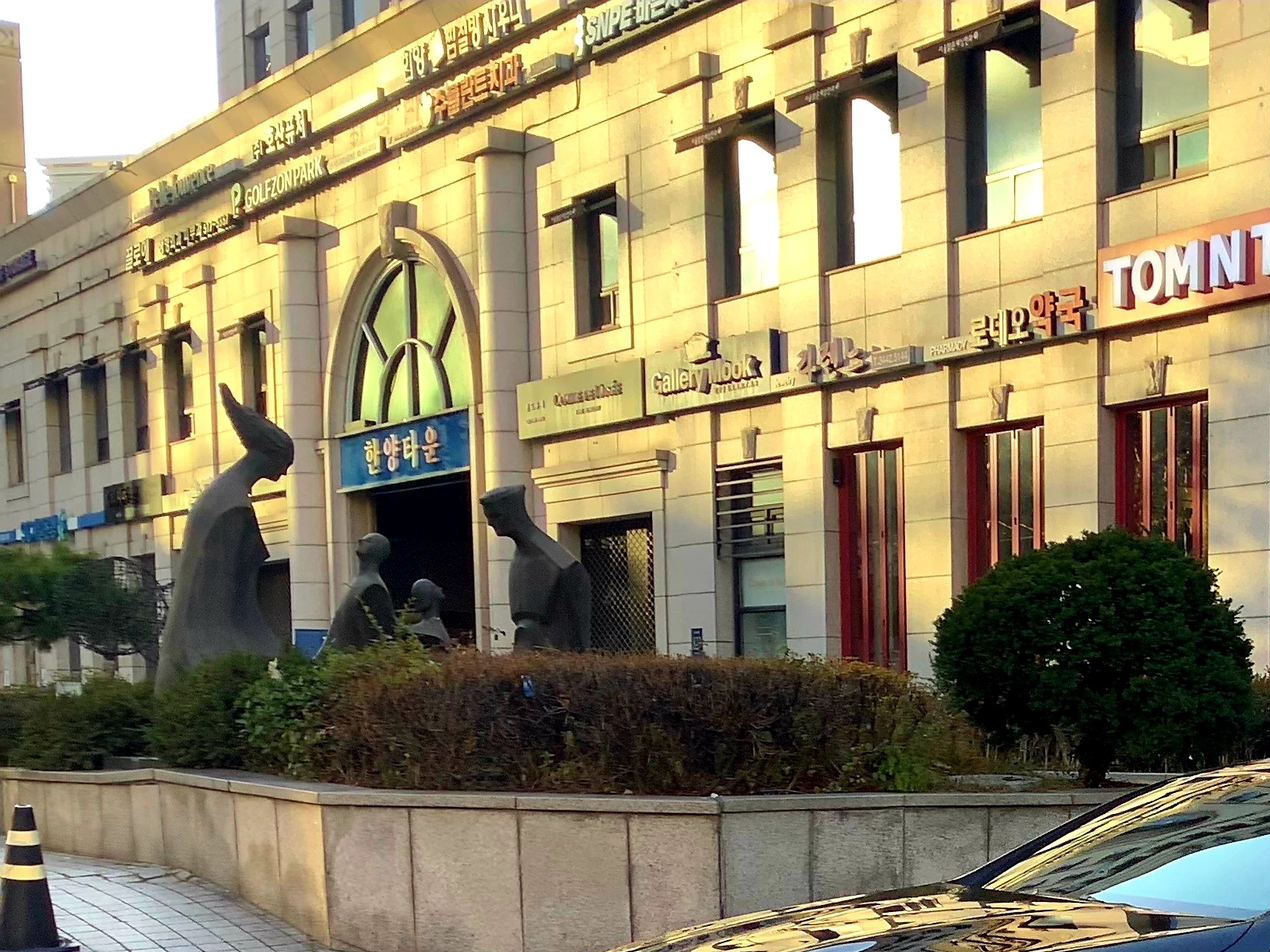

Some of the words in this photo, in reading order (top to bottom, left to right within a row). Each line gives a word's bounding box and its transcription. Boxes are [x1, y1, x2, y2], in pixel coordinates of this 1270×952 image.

[585, 3, 633, 45] SNPE
[1103, 240, 1203, 309] TOM
[1209, 228, 1254, 290] N
[930, 339, 968, 357] PHARMACY
[652, 367, 711, 394] Gallery
[364, 426, 441, 475] 한양타운
